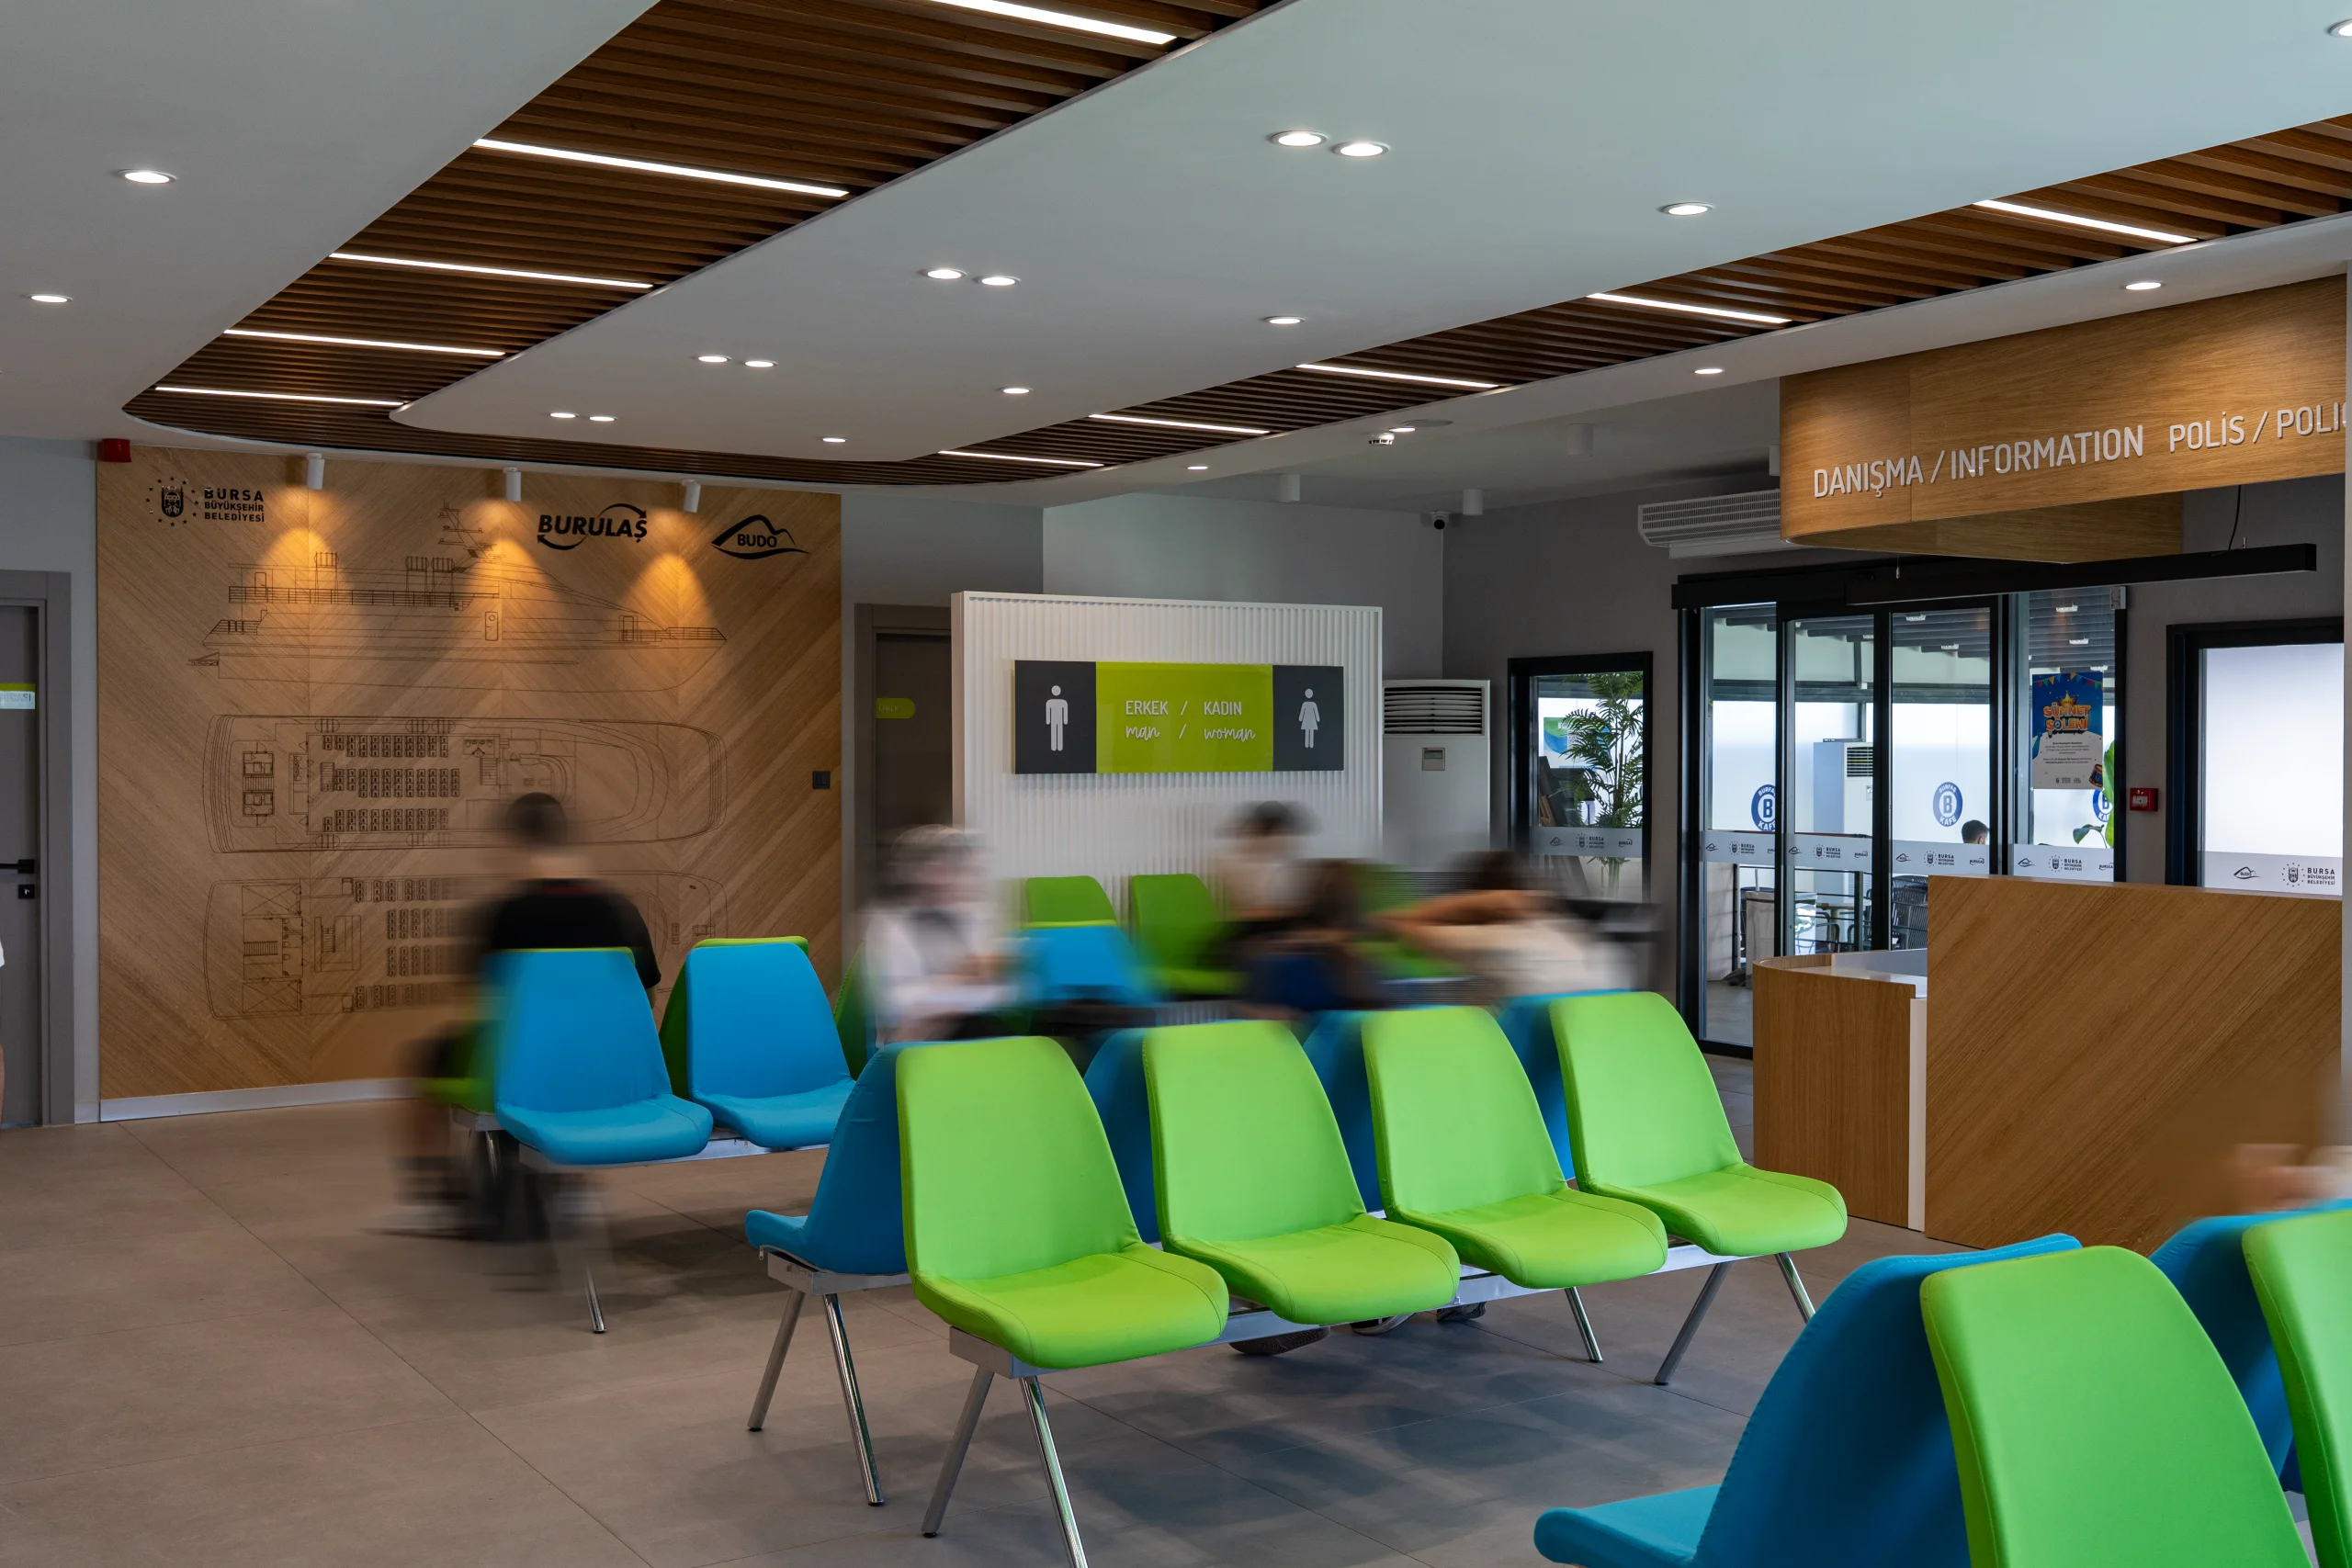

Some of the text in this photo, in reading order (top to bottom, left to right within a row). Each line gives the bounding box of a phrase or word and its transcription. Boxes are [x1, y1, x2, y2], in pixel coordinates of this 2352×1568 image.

[2169, 411, 2245, 453] POLİS
[1814, 455, 1924, 497] DANIŞMA
[1951, 424, 2143, 479] INFORMATION
[204, 487, 264, 502] BURSA
[204, 501, 264, 513] BÜYÜKŞEHİR
[204, 512, 265, 522] BELEDİYESİ
[537, 514, 648, 543] BURULAŞ
[737, 534, 777, 547] BUDO
[1125, 700, 1169, 716] ERKEK
[1204, 701, 1242, 716] KADIN
[2042, 702, 2092, 718] SÜNNET
[1125, 727, 1159, 741] man
[1204, 728, 1256, 742] woman
[1763, 799, 1773, 818] B
[1943, 795, 1952, 813] B
[1939, 816, 1957, 825] KAFE
